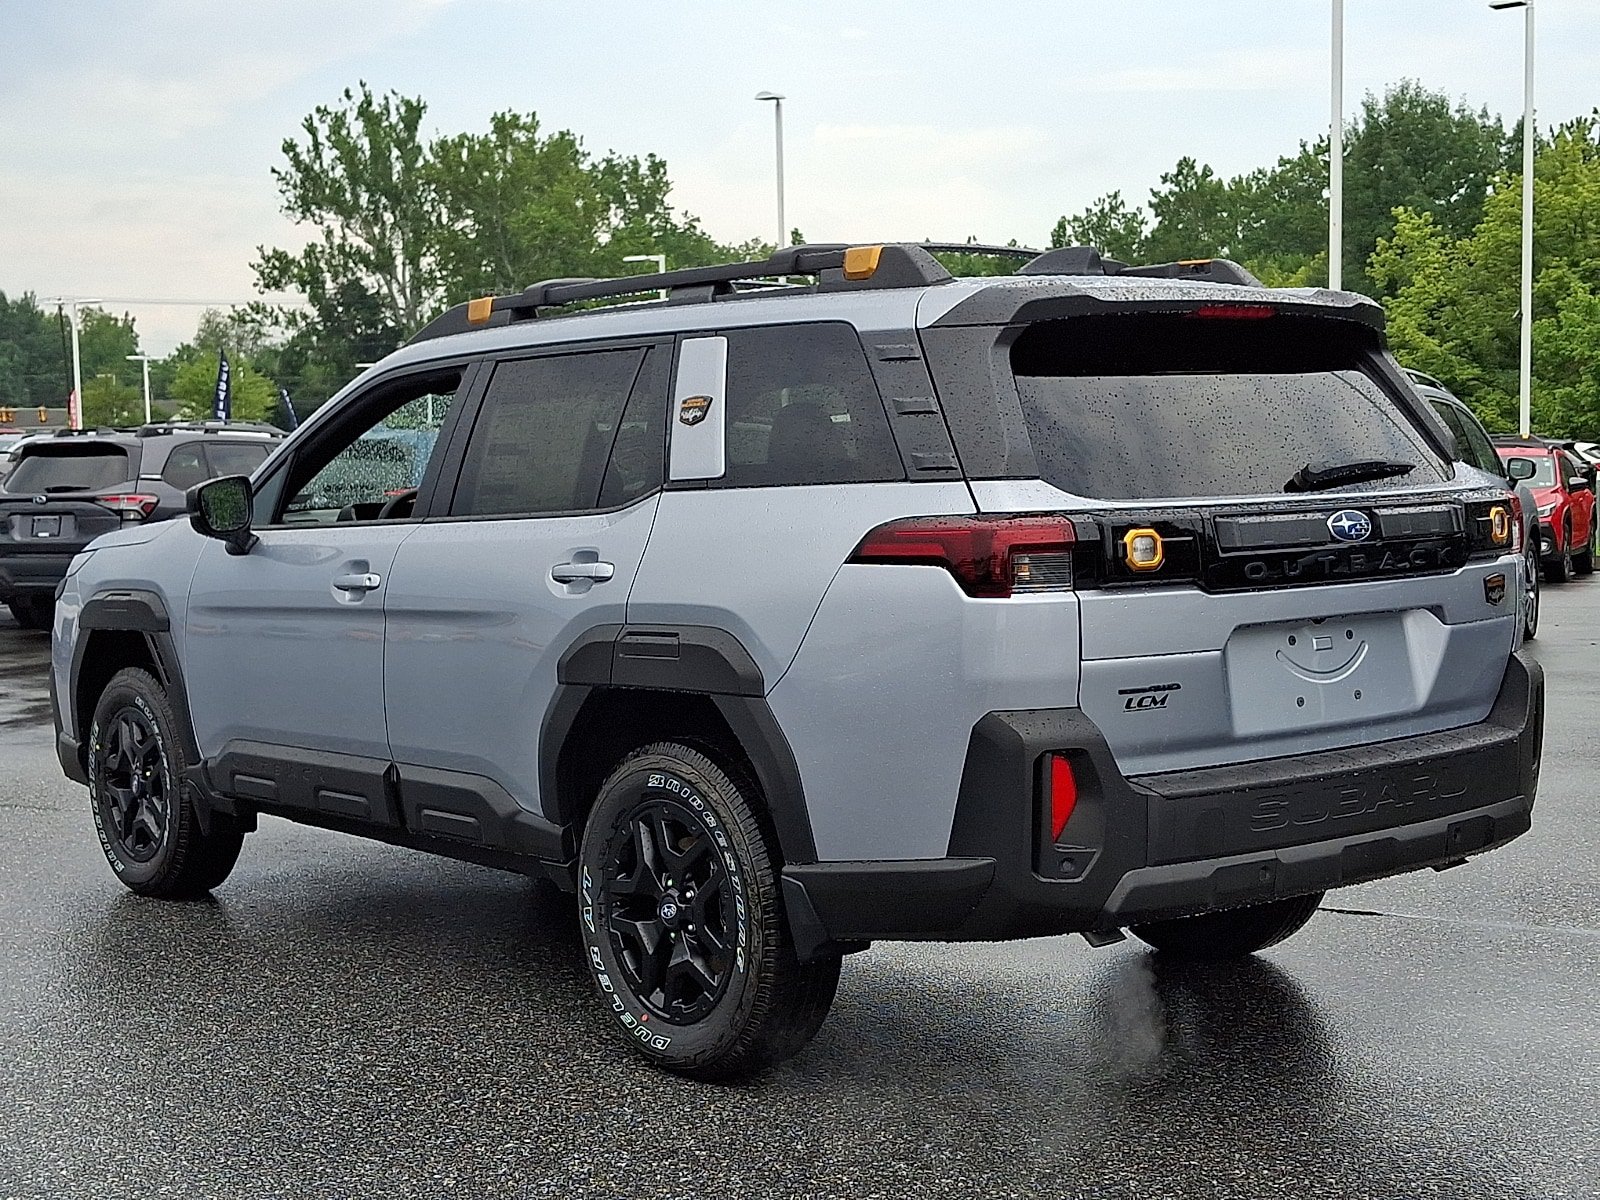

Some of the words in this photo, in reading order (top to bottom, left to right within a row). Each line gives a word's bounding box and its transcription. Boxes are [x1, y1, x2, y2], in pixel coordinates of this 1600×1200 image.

[1244, 545, 1452, 580] OUTBACK
[1124, 693, 1169, 710] LCM
[1250, 768, 1468, 833] SUBARU
[647, 773, 746, 974] BRIDGESTONE
[589, 945, 671, 1051] DUELER
